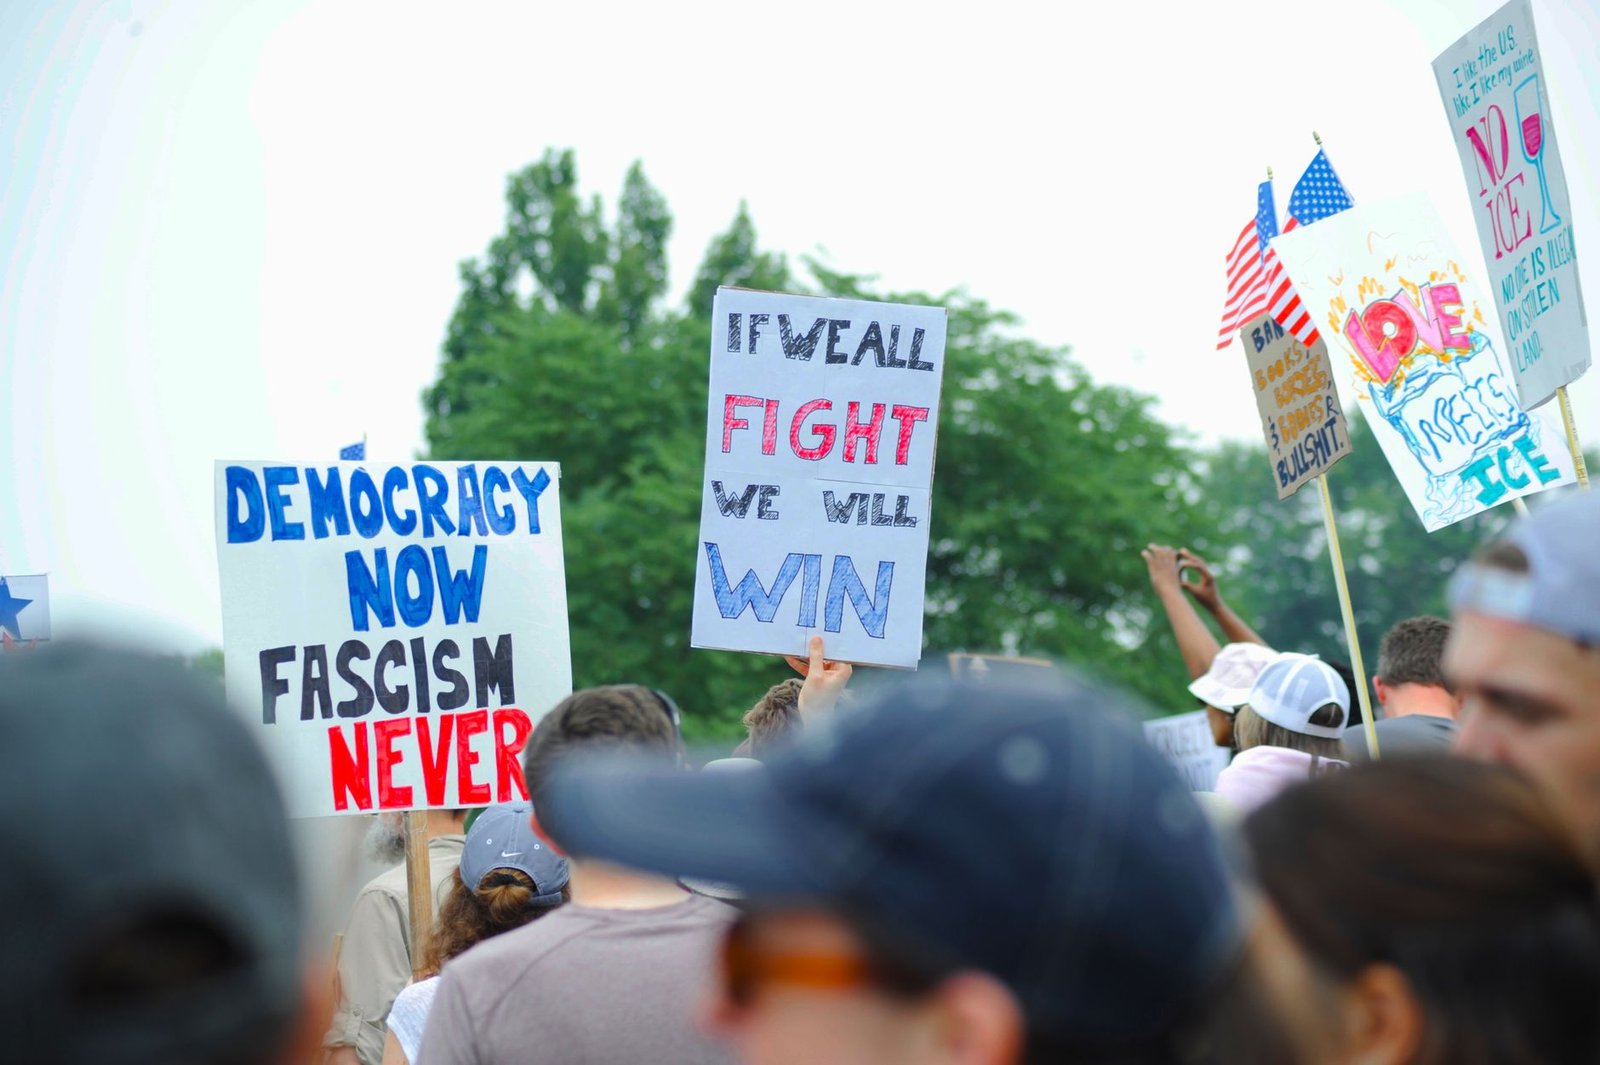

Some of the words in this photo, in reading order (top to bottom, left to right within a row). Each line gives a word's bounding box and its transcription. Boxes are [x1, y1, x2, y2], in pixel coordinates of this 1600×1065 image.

[1453, 93, 1472, 118] like
[1479, 74, 1497, 96] like
[1498, 64, 1512, 87] my
[1513, 48, 1534, 73] wine
[1462, 60, 1478, 82] like
[1478, 43, 1497, 70] the
[1466, 104, 1509, 197] NO
[1485, 172, 1532, 260] ICE
[1531, 246, 1546, 280] IS
[727, 312, 770, 354] IF
[778, 313, 851, 365] WE
[851, 320, 934, 371] ALL
[1343, 281, 1471, 384] LOVE
[1507, 307, 1523, 341] ON
[1522, 277, 1560, 329] STOLEN
[721, 394, 930, 465] FIGHT
[1326, 395, 1340, 418] R
[1419, 373, 1514, 462] MELTS
[224, 463, 552, 544] DEMOCRACY
[711, 480, 780, 520] WE
[823, 490, 918, 527] WILL
[1459, 434, 1561, 507] ICE
[344, 543, 488, 632] NOW
[704, 541, 895, 639] WIN
[258, 633, 516, 725] FASCISM
[327, 708, 534, 812] NEVER
